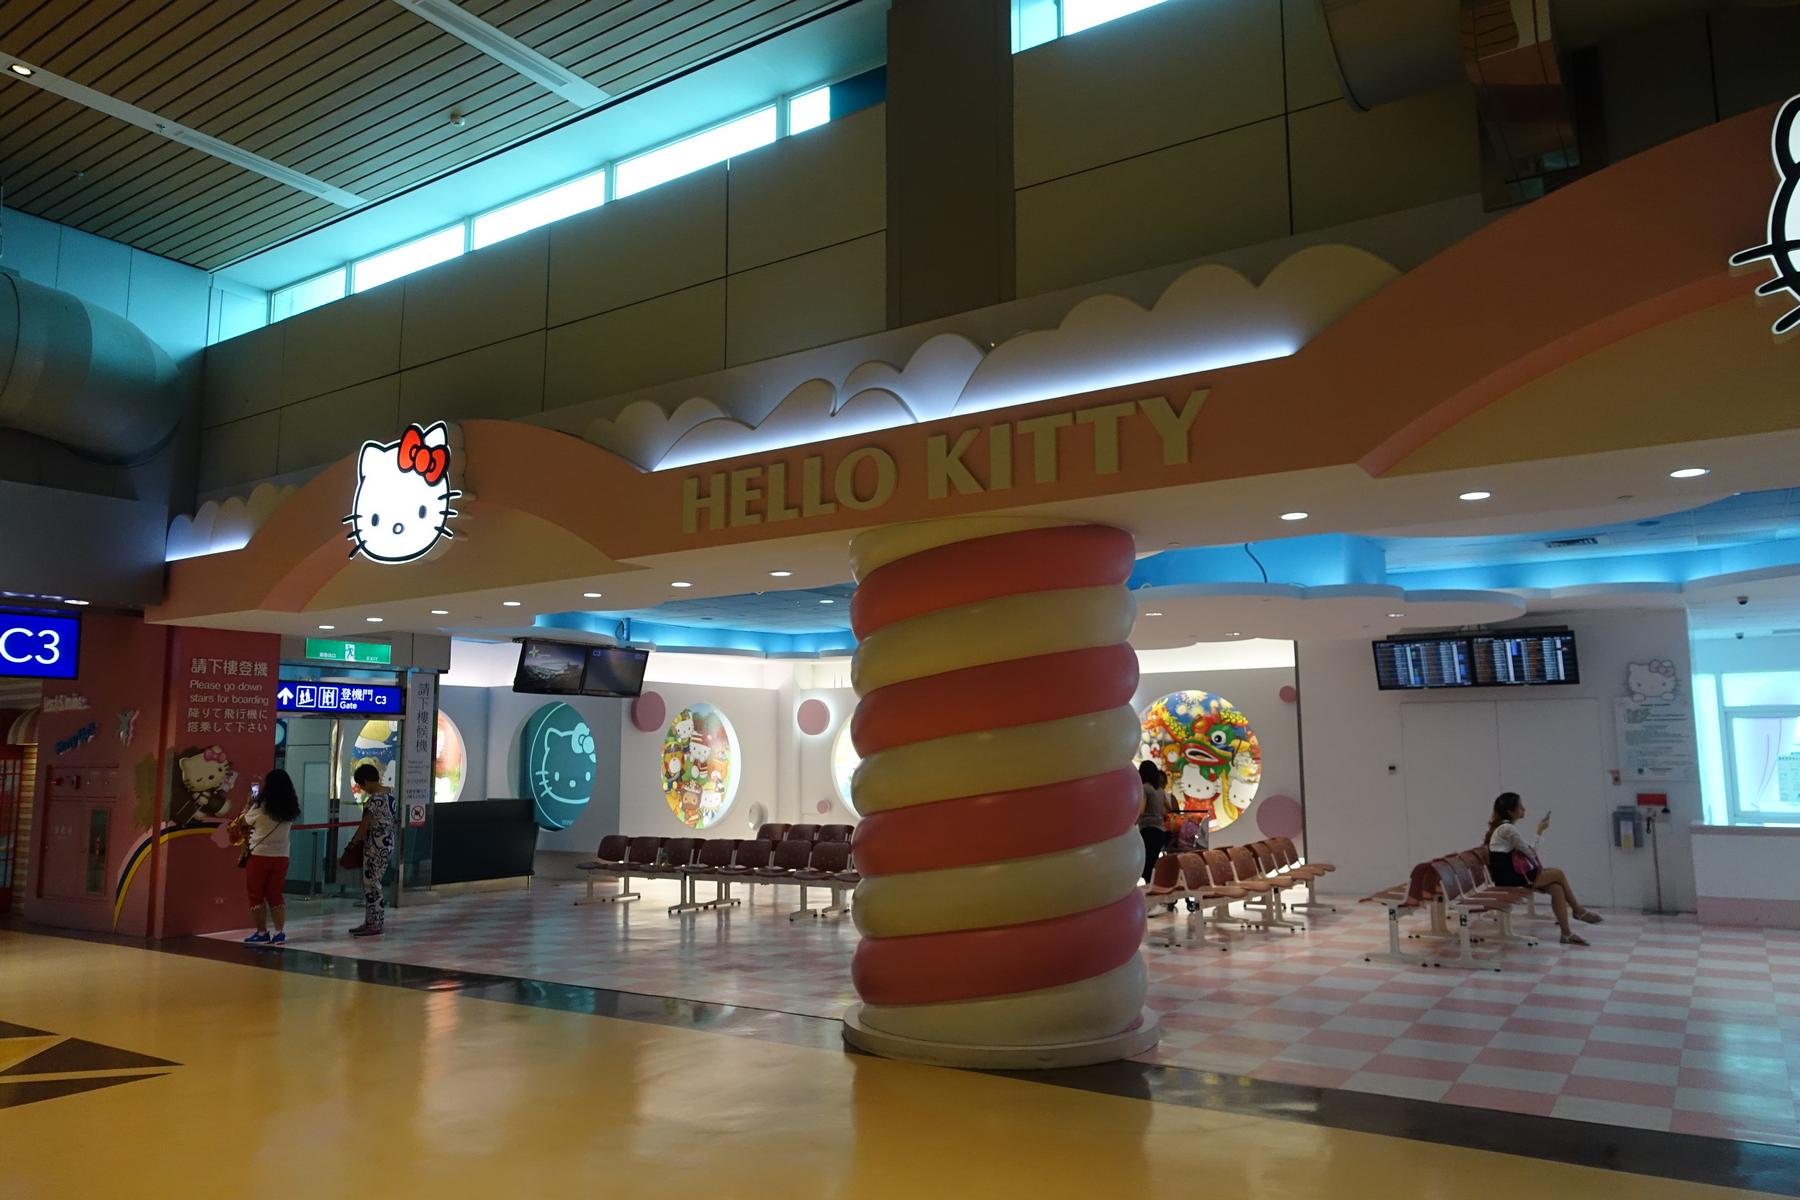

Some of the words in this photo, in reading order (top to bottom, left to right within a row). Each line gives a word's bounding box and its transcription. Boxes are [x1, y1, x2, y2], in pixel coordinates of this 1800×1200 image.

[681, 446, 898, 534] HELLO
[926, 389, 1209, 501] KITTY
[0, 627, 60, 665] C3
[191, 658, 268, 677] 請下樓登機
[190, 680, 220, 690] Please
[223, 683, 235, 692] go
[238, 682, 262, 691] down
[190, 694, 214, 703] stairs
[217, 694, 229, 703] for
[232, 695, 269, 706] boarding
[341, 688, 374, 701] 登機門
[375, 696, 387, 705] C3
[340, 701, 358, 710] Gate
[187, 707, 268, 720] 降りて飛行機に
